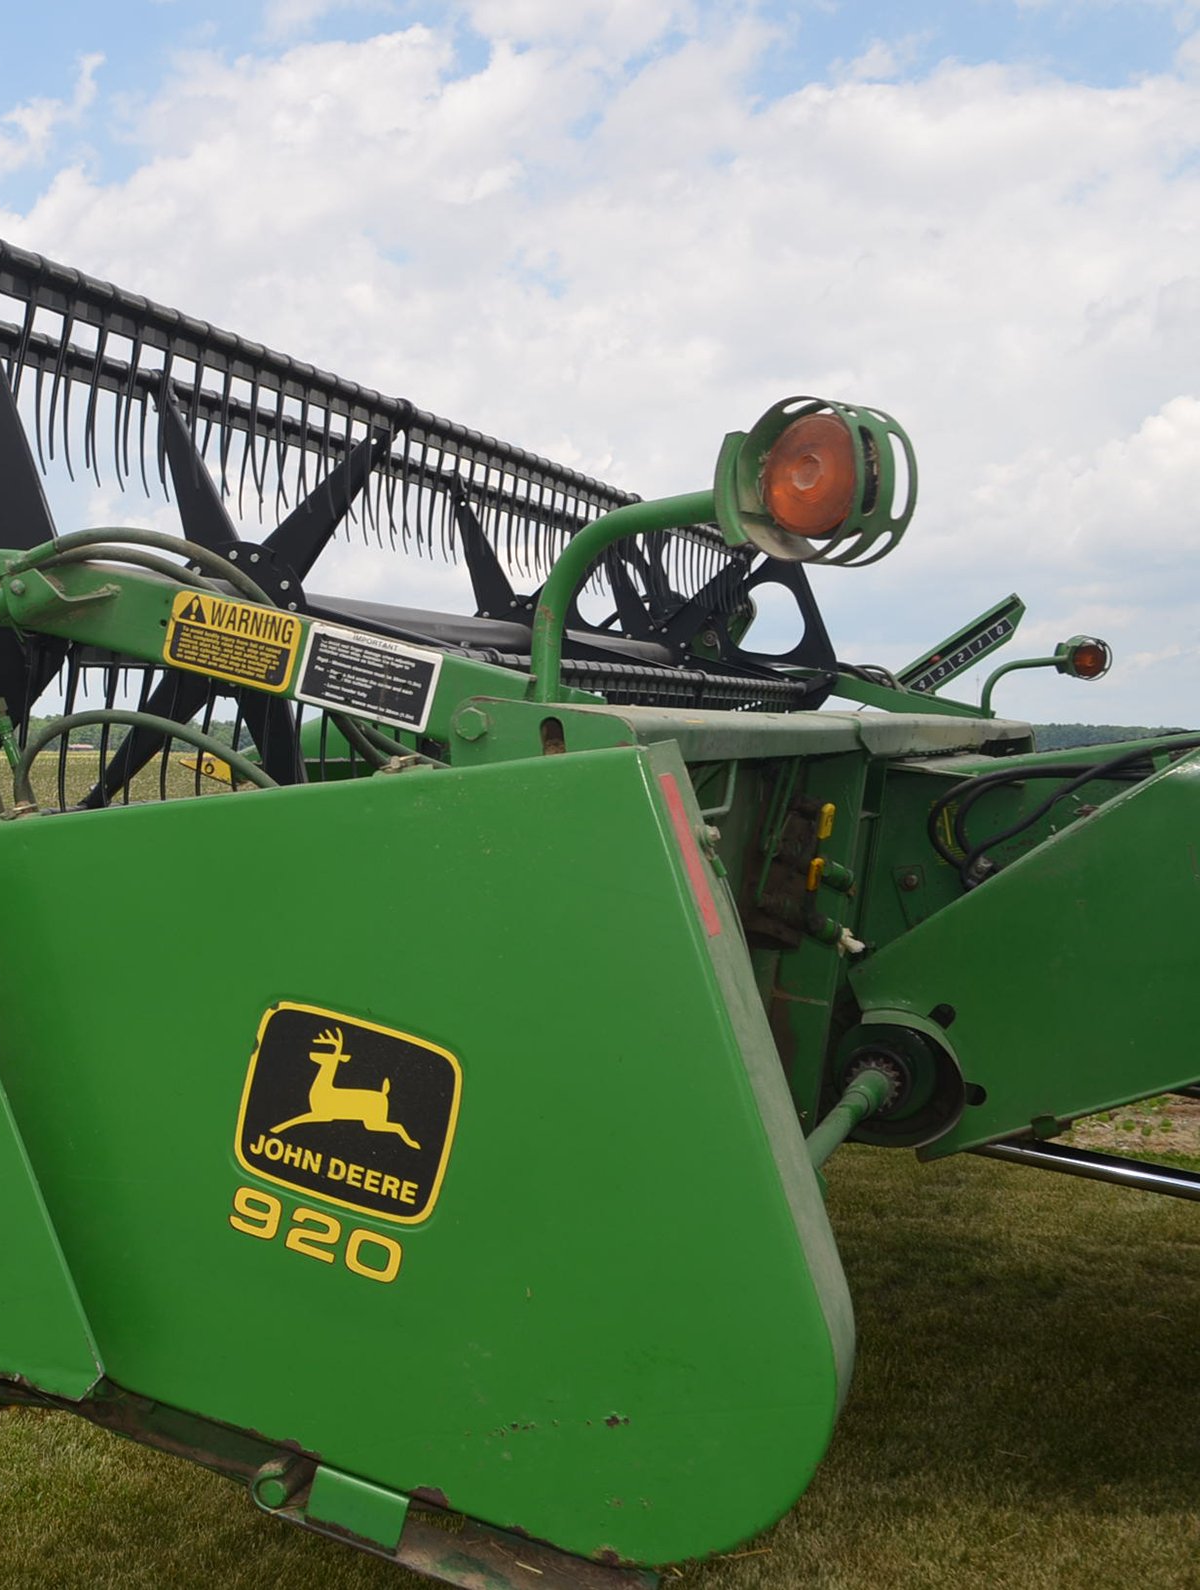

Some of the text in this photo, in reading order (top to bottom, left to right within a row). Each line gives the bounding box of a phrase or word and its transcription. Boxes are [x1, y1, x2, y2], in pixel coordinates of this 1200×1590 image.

[211, 601, 294, 644] WARNING
[352, 634, 400, 652] IMPORTANT
[958, 653, 964, 662] 2
[250, 1134, 419, 1205] JOHN DEERE
[229, 1186, 402, 1283] 920
